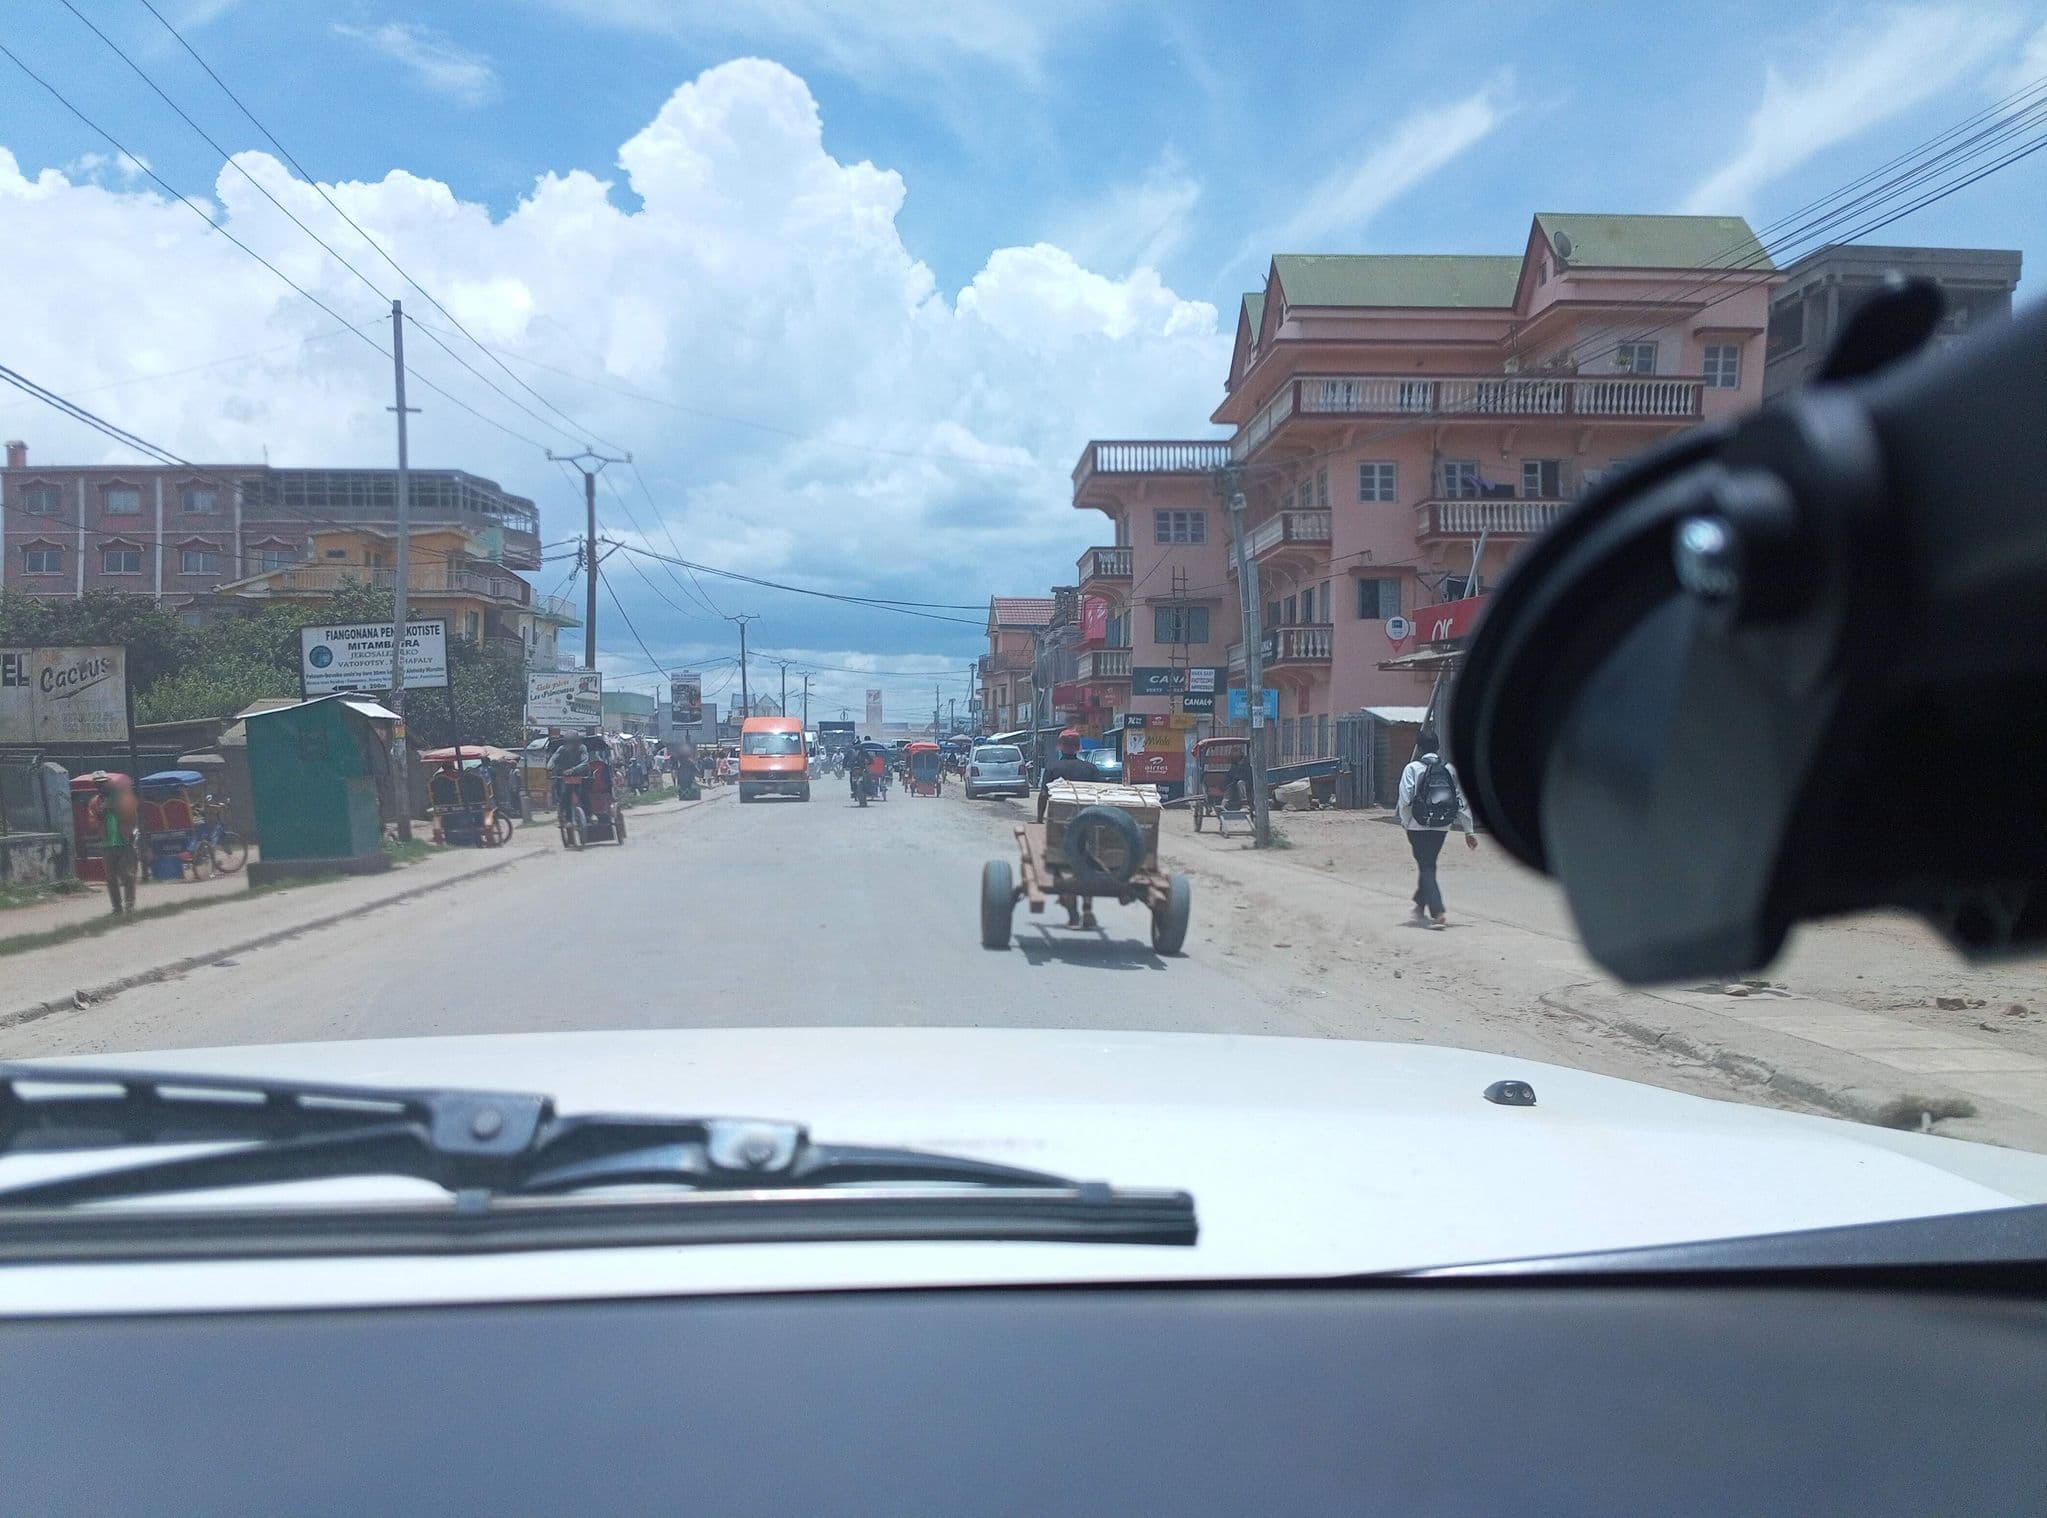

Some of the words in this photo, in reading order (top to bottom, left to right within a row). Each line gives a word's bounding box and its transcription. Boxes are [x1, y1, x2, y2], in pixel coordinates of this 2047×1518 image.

[326, 627, 379, 641] FIANGONANA
[381, 625, 440, 638] PENKOTISTE
[1184, 698, 1213, 706] CANAL+
